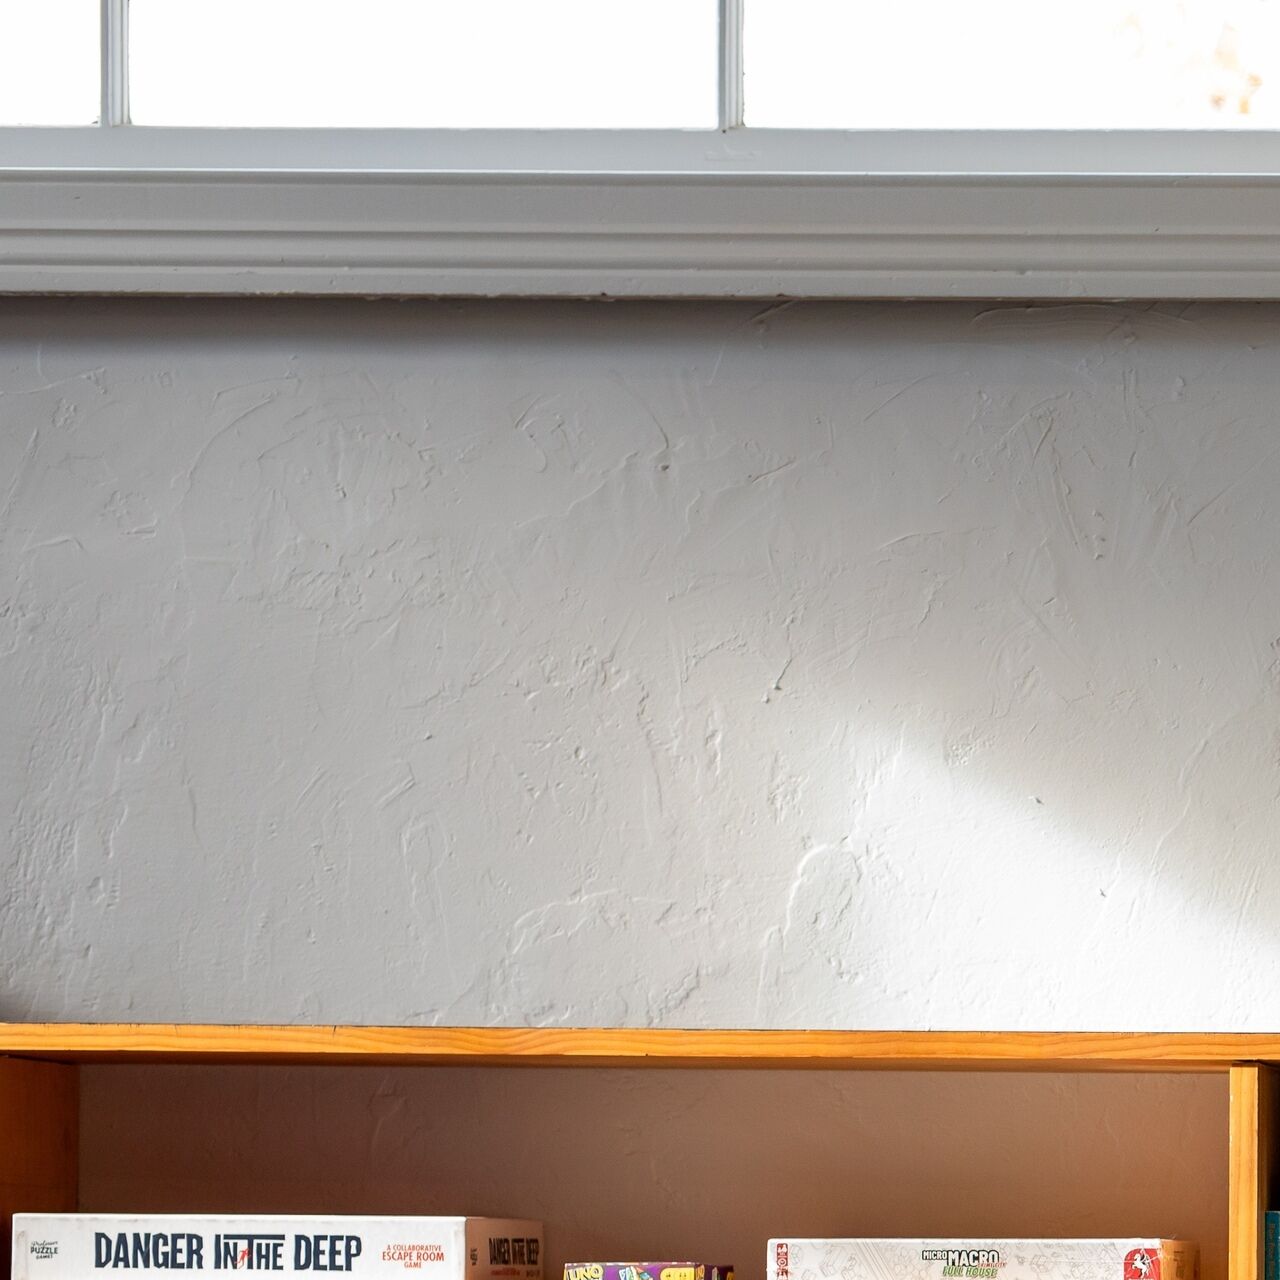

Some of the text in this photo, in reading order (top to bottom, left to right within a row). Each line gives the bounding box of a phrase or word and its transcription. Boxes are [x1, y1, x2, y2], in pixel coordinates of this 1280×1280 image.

[94, 1232, 362, 1272] DANGER IN THE DEEP
[382, 1252, 444, 1262] ESCAPE ROOM
[943, 1266, 998, 1278] FULL HOUSE
